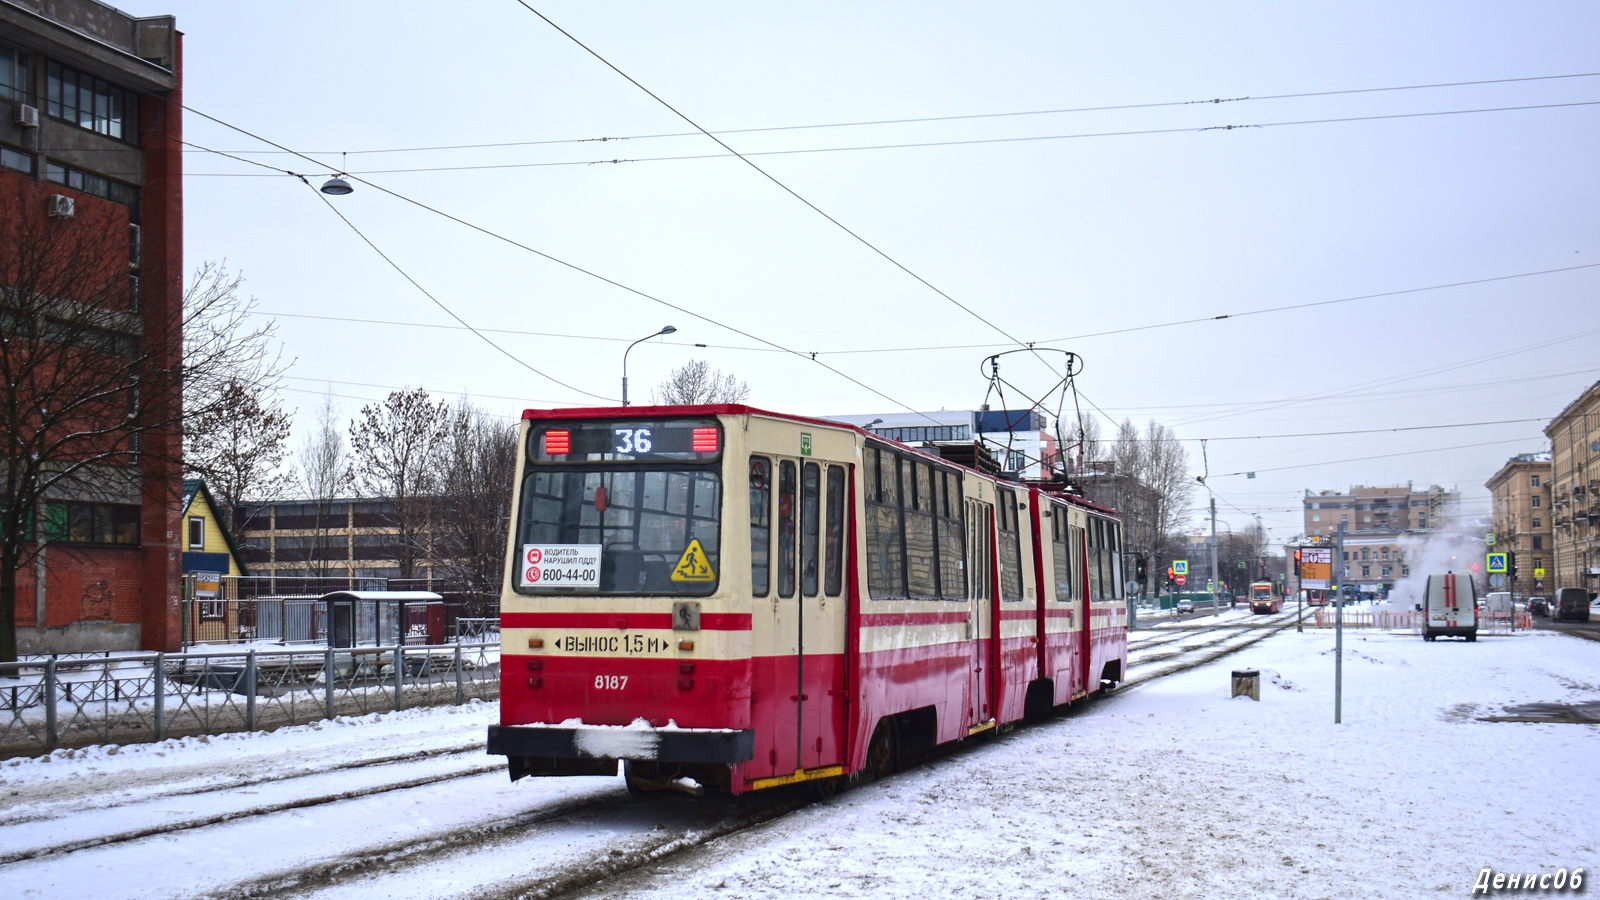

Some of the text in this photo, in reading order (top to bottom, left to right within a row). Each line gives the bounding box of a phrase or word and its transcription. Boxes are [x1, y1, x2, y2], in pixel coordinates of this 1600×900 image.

[615, 429, 652, 453] 36
[544, 548, 579, 556] ВОДИТЕЛЬ
[543, 557, 597, 566] НАРУШИЛ ПДД?
[543, 568, 596, 582] 600-44-00
[565, 634, 659, 656] ВЫНОС 1,5 М
[594, 674, 629, 690] 8187
